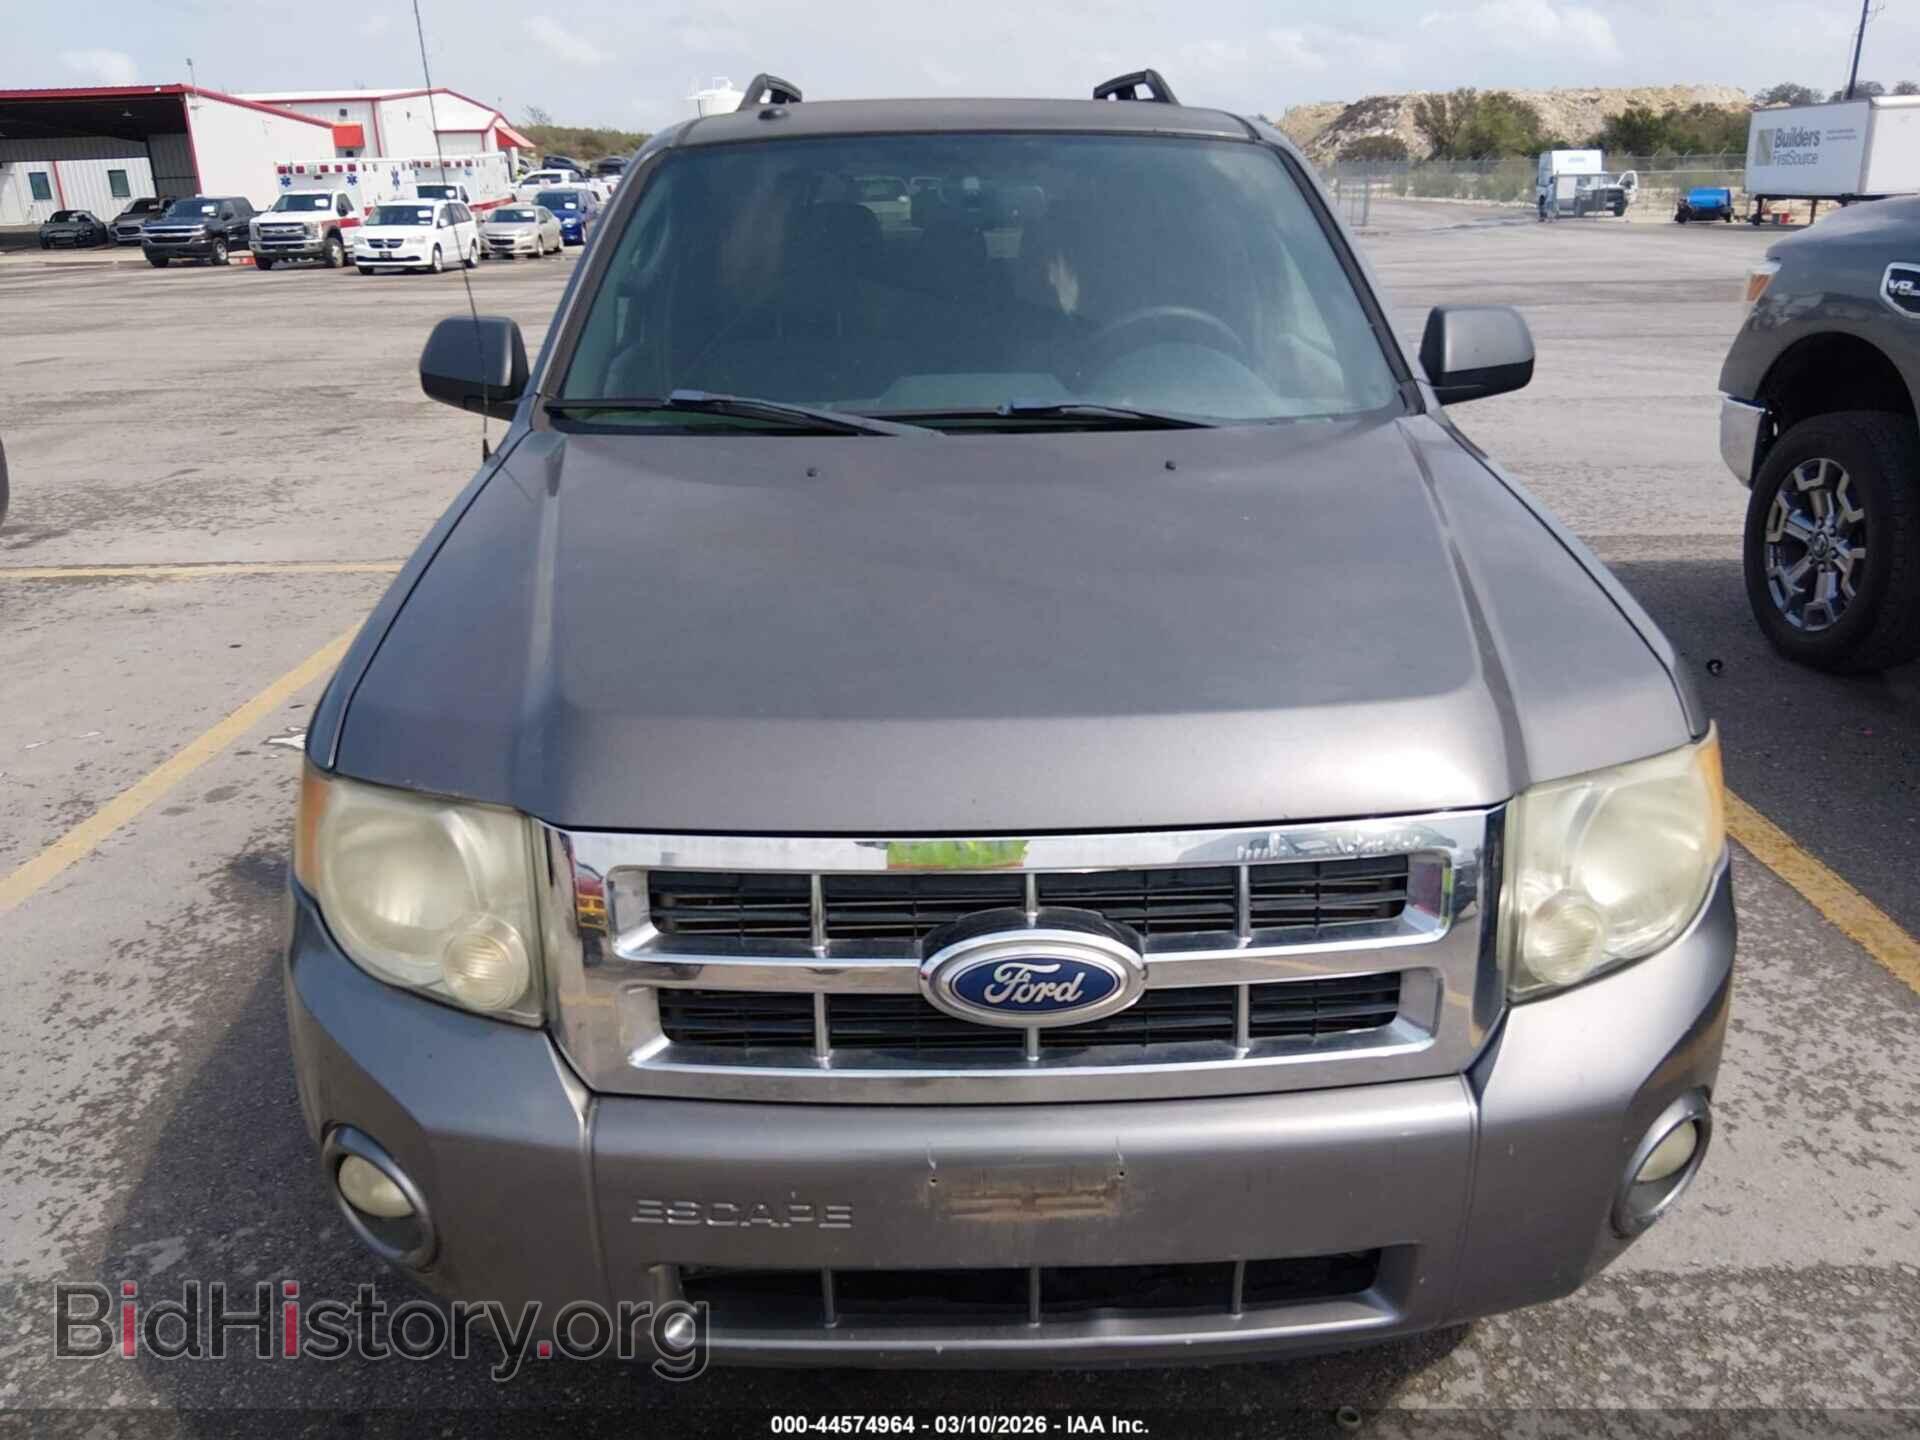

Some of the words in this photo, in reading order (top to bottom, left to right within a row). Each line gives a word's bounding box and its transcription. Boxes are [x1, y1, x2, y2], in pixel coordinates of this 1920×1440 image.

[1774, 127, 1821, 149] Builders
[983, 962, 1086, 1004] Ford
[631, 1199, 852, 1229] ESCAPE
